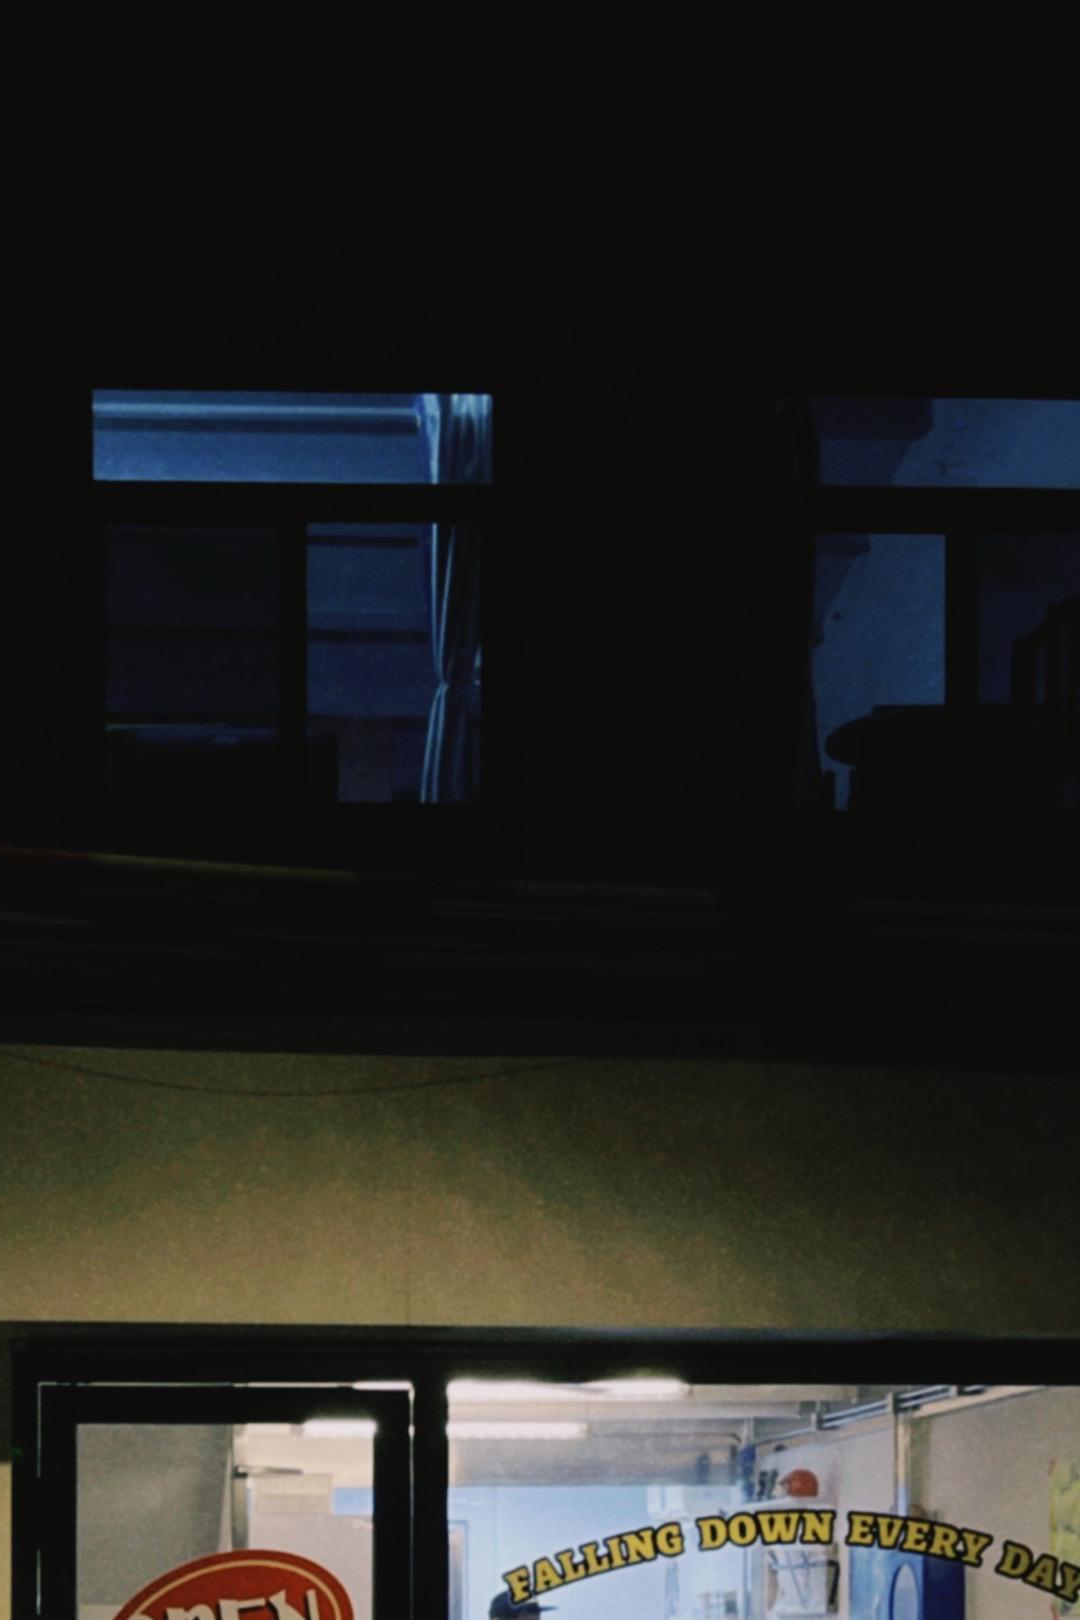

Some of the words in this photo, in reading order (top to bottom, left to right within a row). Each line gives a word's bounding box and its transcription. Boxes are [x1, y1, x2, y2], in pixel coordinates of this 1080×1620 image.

[502, 1521, 686, 1605] FALLING
[696, 1509, 835, 1552] DOWN
[845, 1511, 993, 1568] EVERY
[995, 1540, 1080, 1602] DAY
